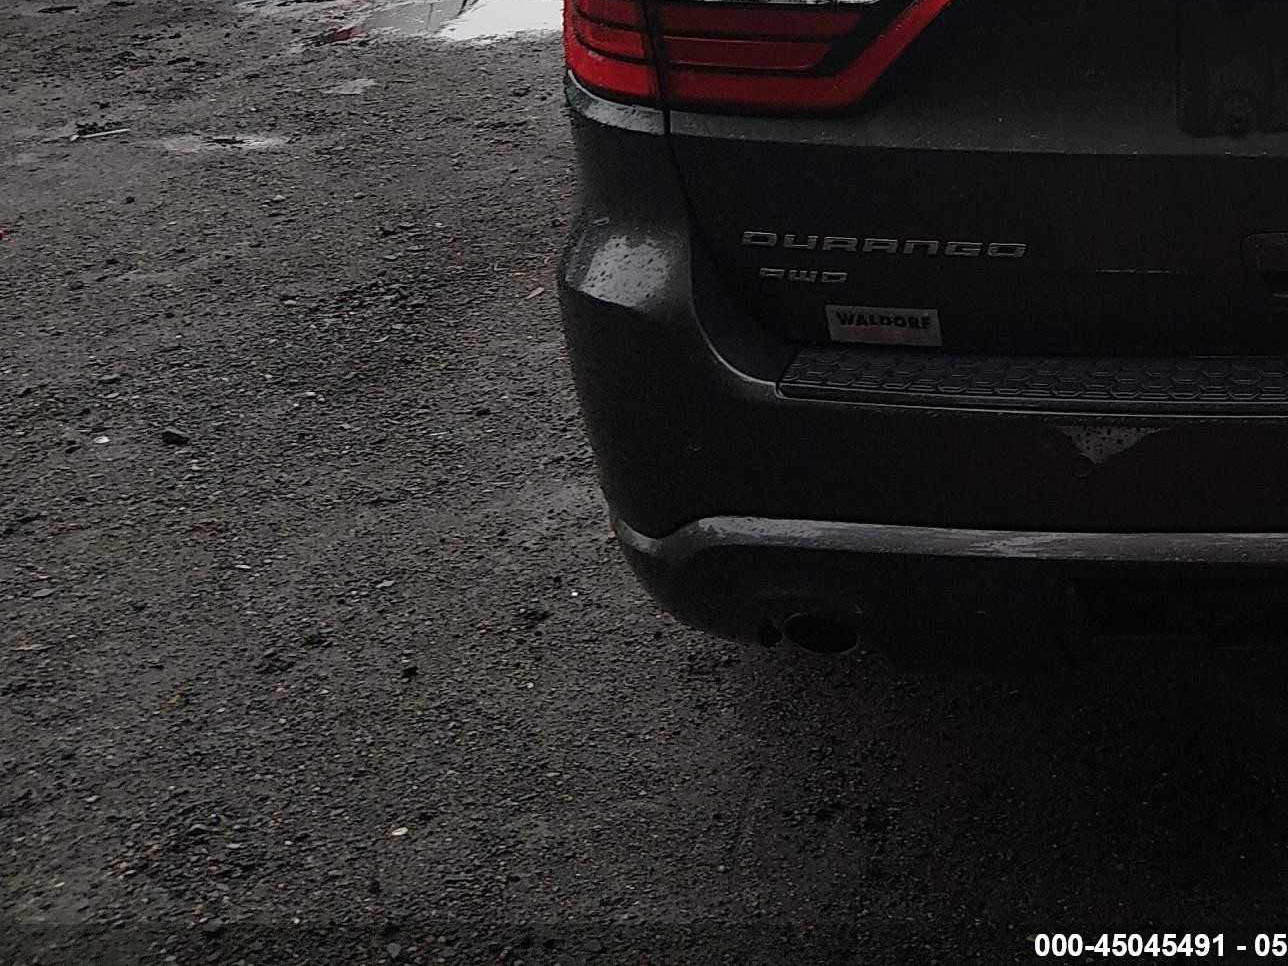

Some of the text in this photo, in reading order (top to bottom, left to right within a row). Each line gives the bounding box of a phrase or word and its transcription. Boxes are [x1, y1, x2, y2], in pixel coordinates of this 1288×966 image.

[741, 231, 1028, 258] DURANGO
[759, 267, 849, 284] AWD
[835, 311, 931, 329] WALDORF
